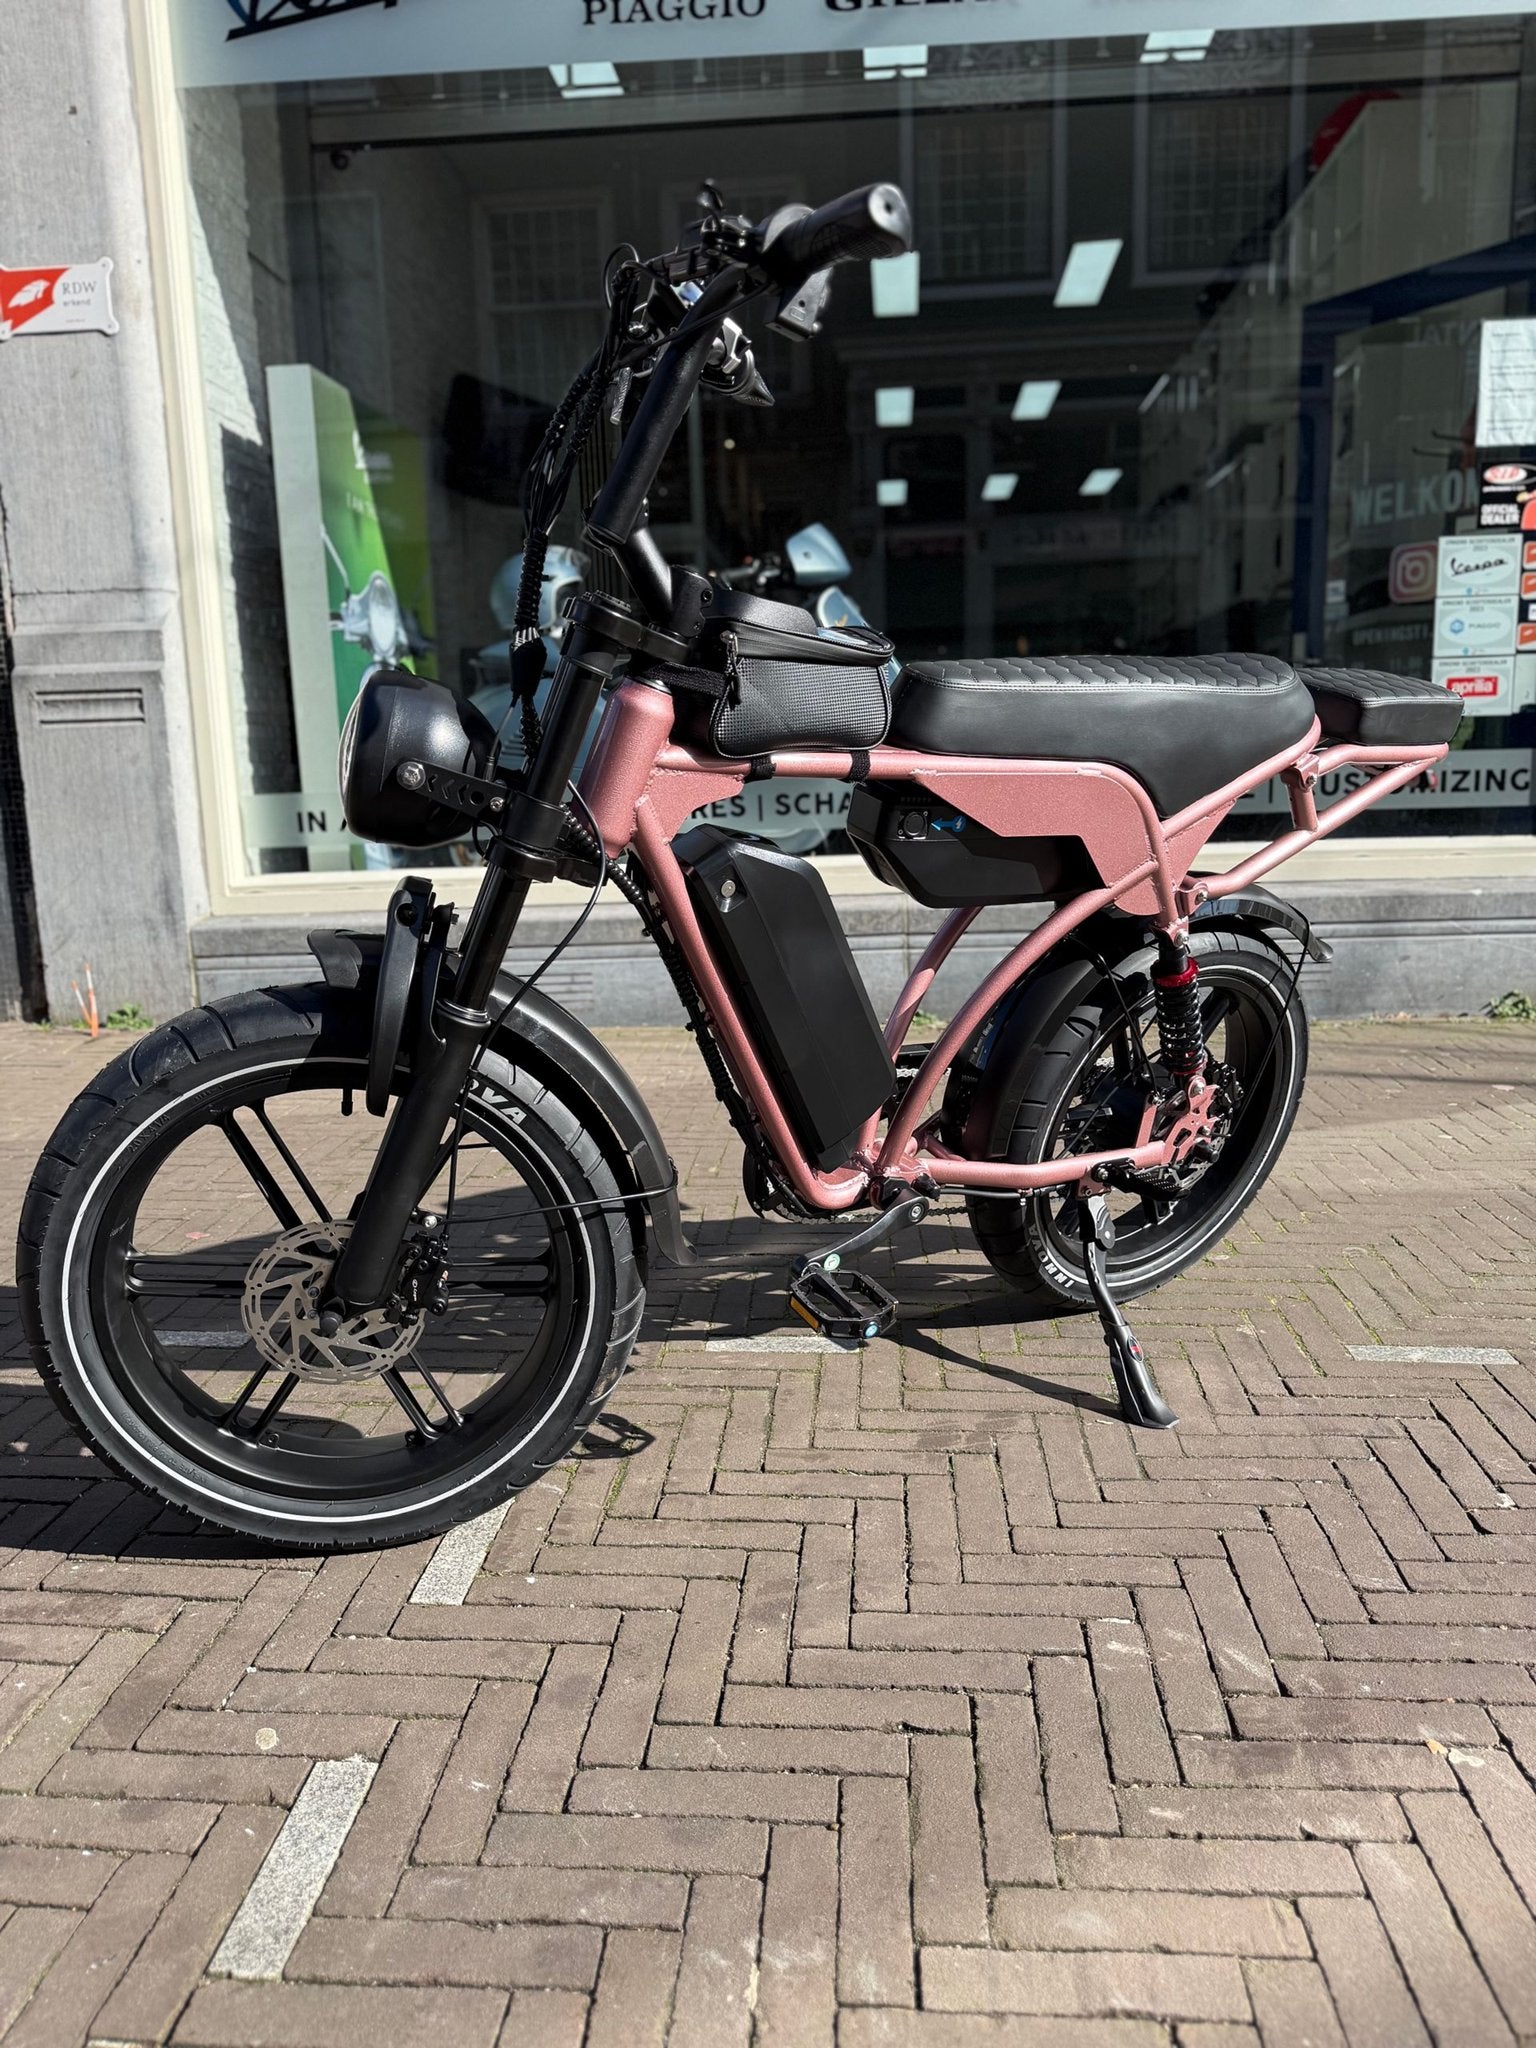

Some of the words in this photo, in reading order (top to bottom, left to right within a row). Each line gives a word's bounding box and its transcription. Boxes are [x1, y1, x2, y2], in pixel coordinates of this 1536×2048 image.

[582, 0, 767, 25] PIAGGIO
[61, 281, 97, 295] RDW
[63, 298, 91, 307] erkend
[1450, 557, 1508, 577] Vespa
[1451, 678, 1494, 695] aprilia
[297, 811, 327, 833] IN
[1027, 1223, 1075, 1289] INNOVA
